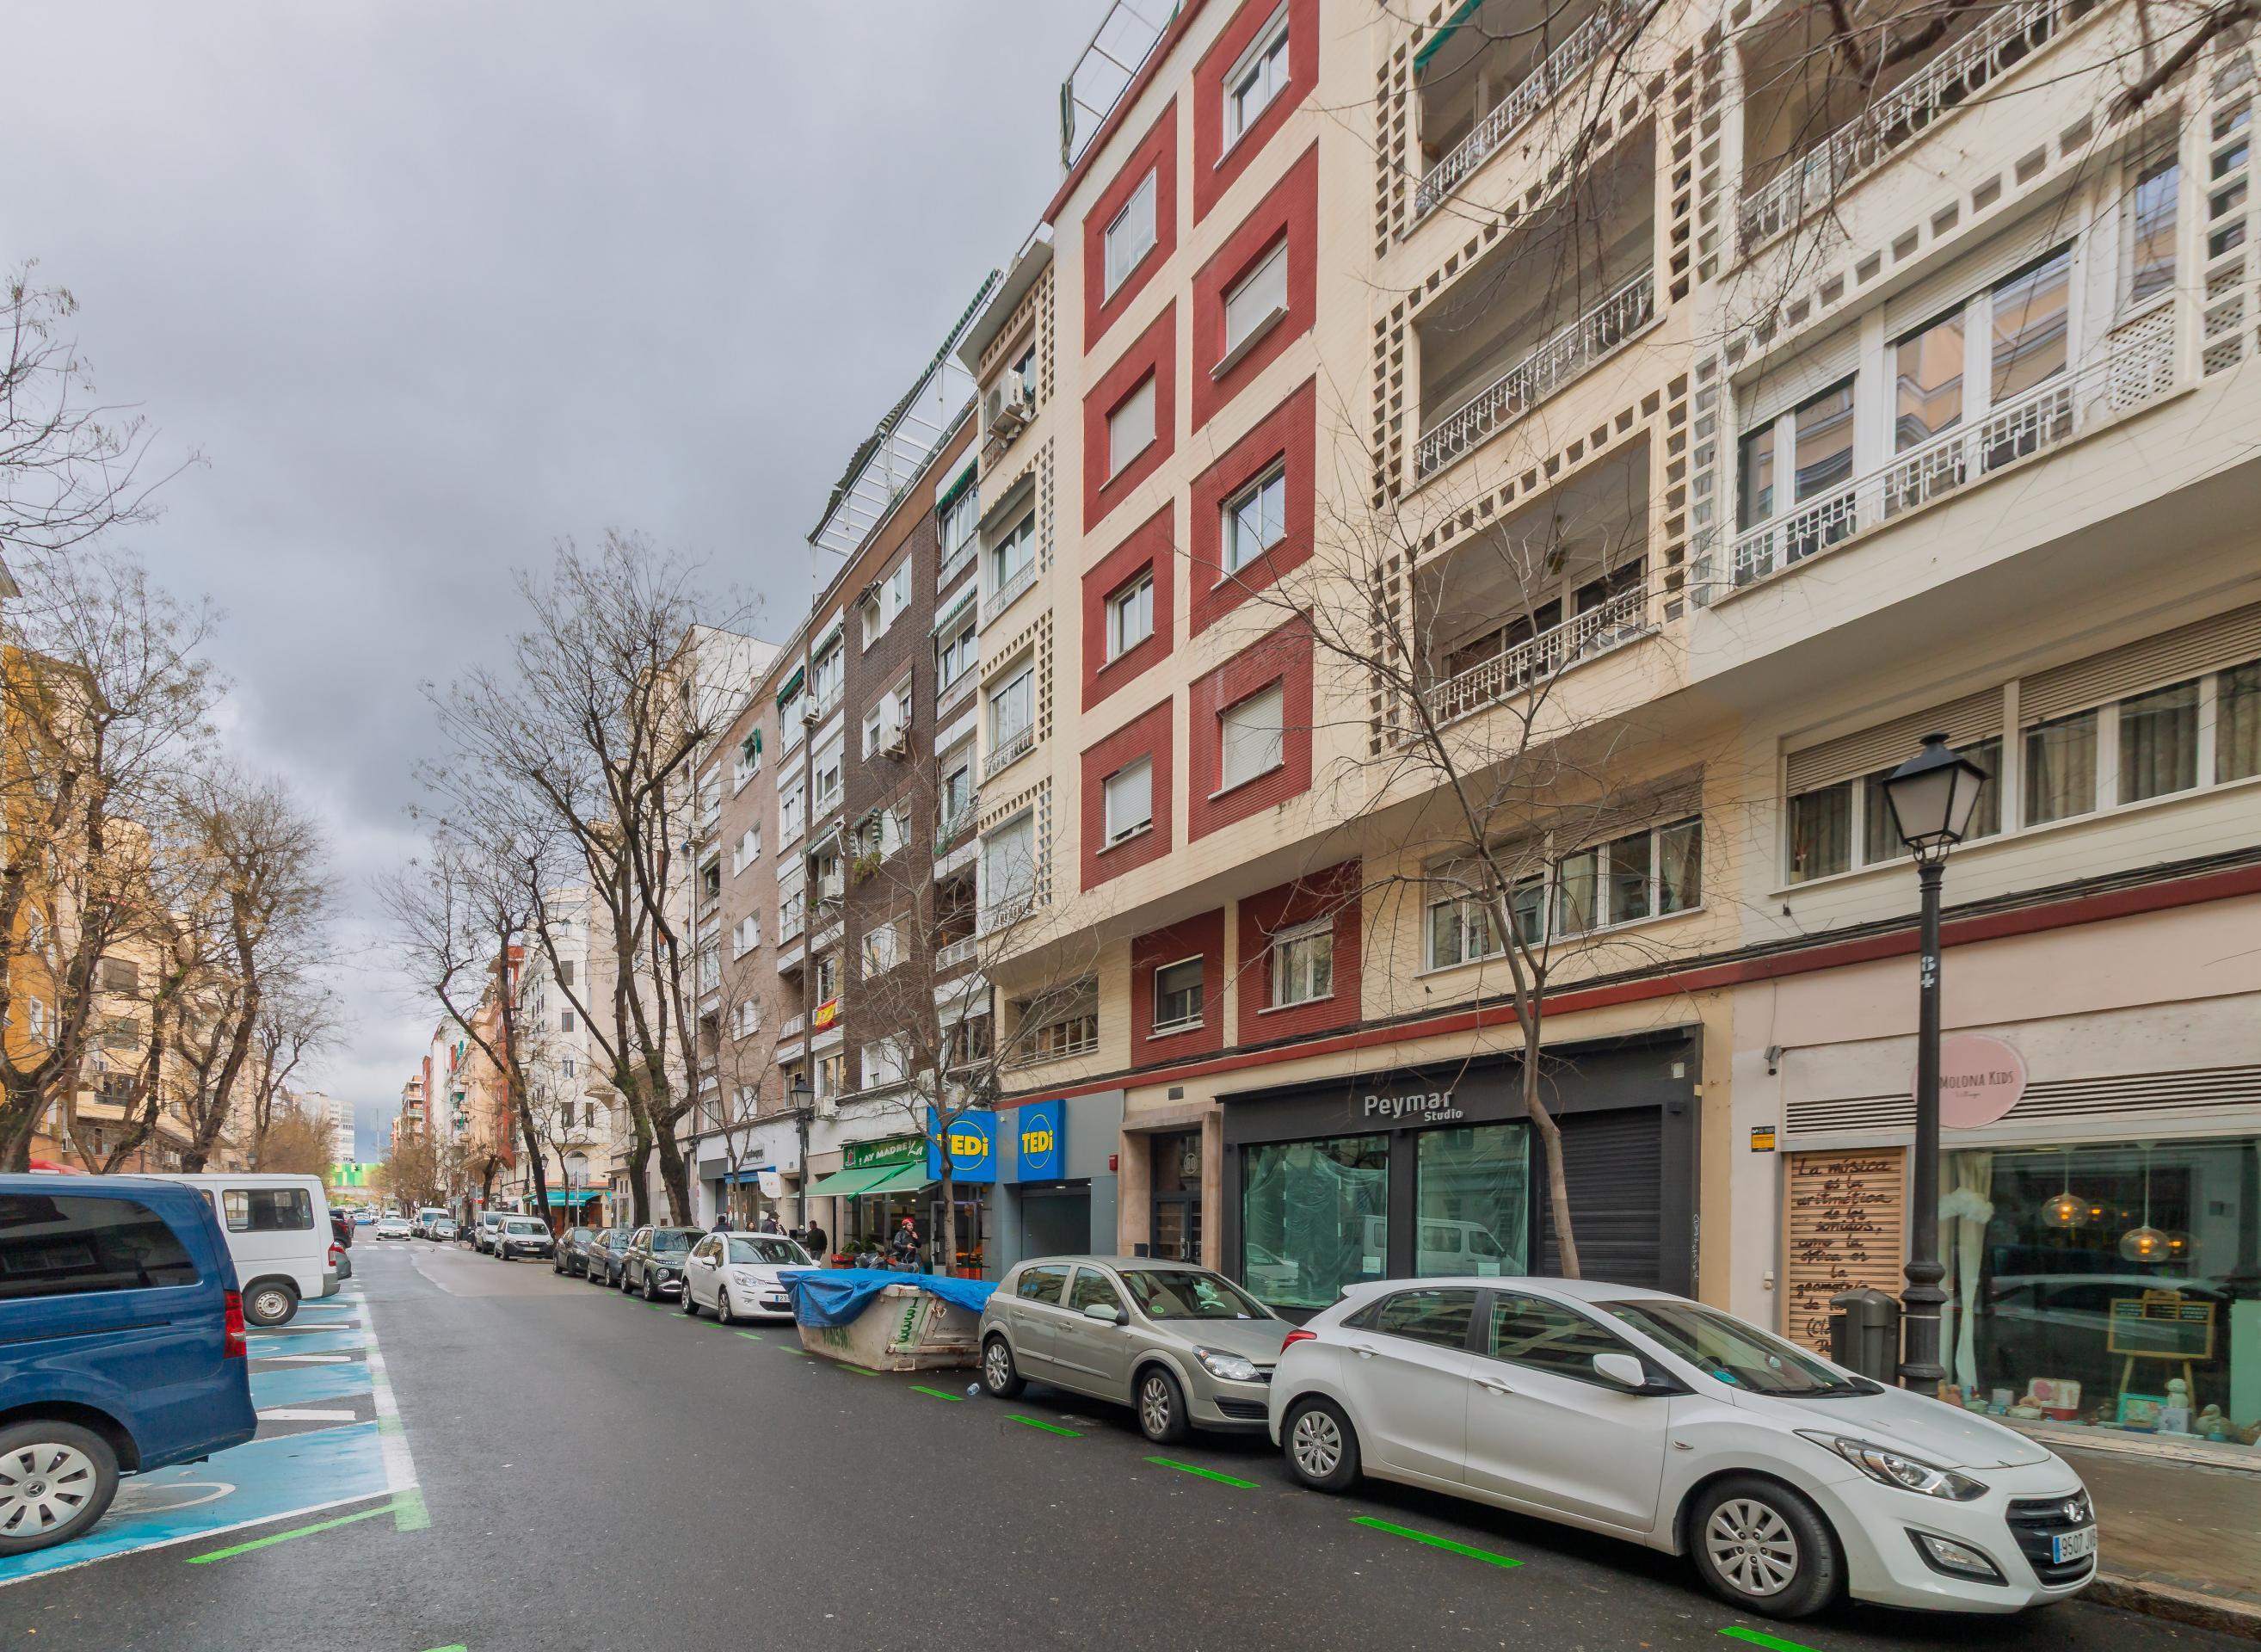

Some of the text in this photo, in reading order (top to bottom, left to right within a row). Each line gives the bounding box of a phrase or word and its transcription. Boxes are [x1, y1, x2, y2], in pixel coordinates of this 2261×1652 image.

[1365, 1090, 1452, 1119] Peymar
[1424, 1108, 1463, 1122] Studio
[1022, 1130, 1053, 1154] TEDi
